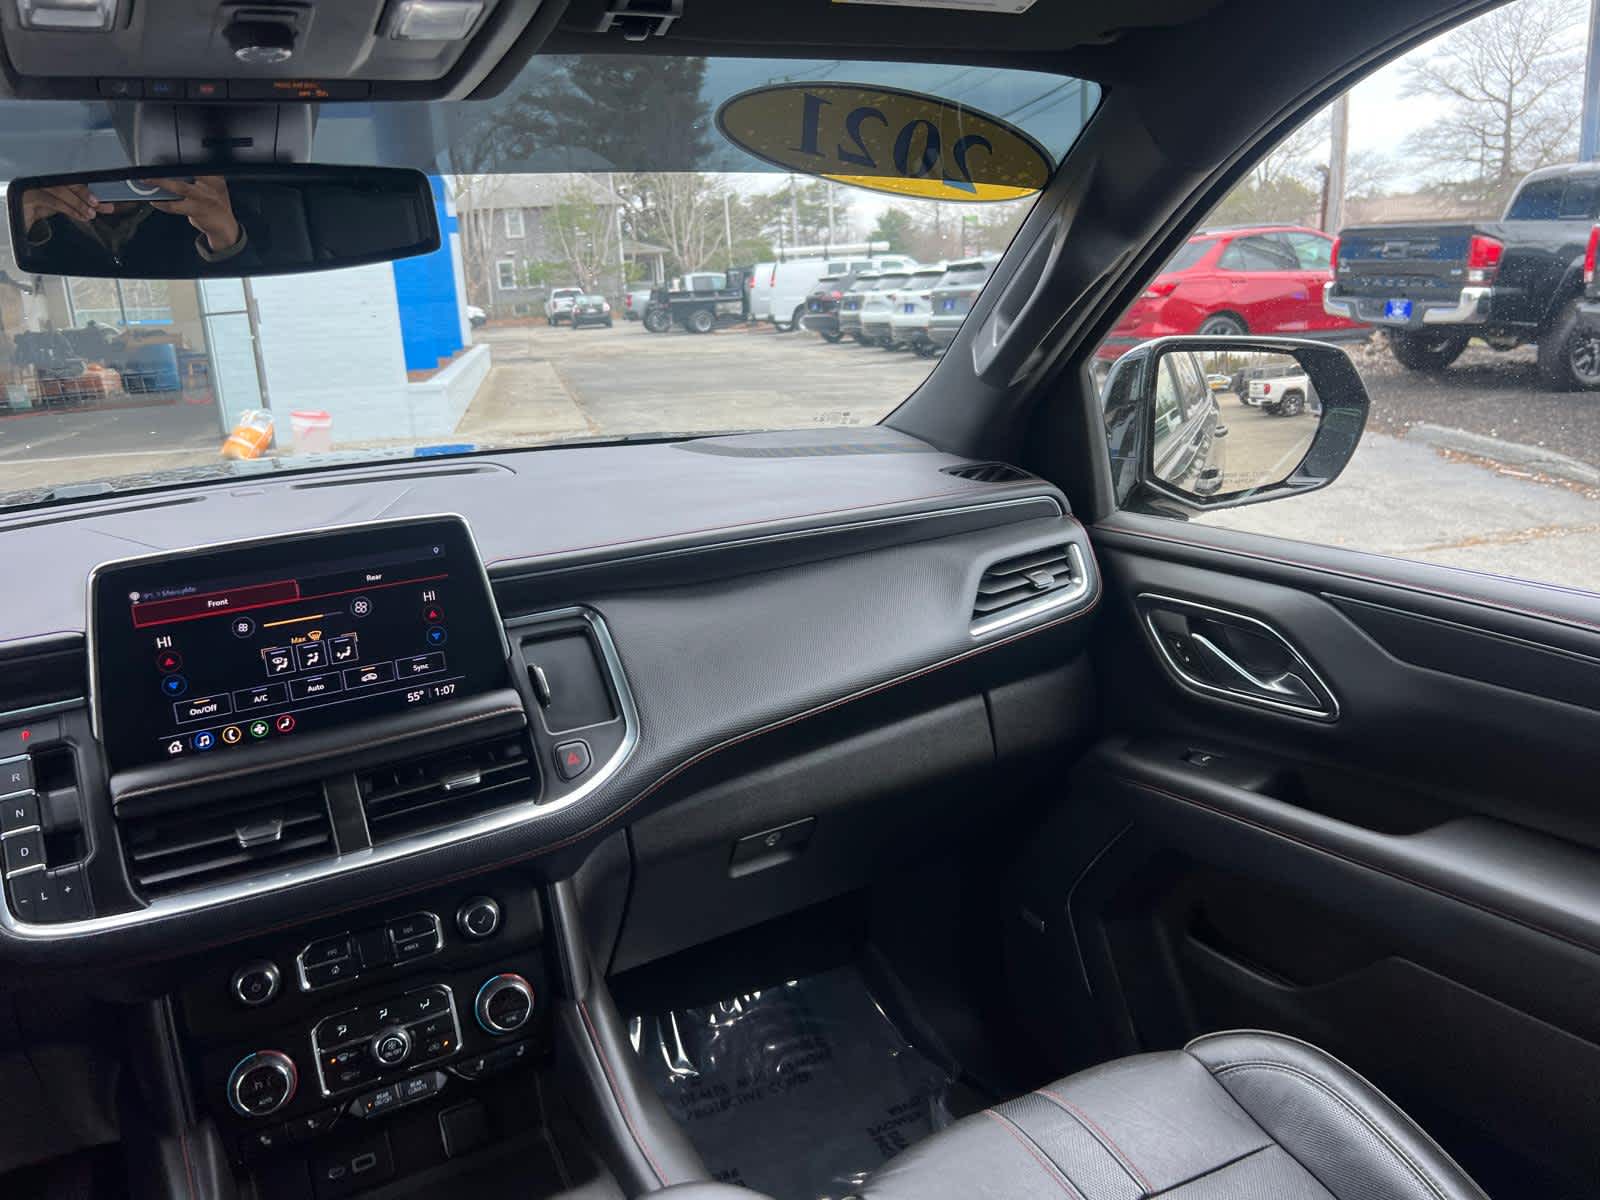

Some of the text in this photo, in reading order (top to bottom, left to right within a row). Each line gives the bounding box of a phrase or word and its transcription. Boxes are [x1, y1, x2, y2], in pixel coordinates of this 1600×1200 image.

[366, 574, 382, 582] Rear
[423, 590, 436, 602] HI
[207, 598, 229, 608] Front
[156, 635, 172, 649] HI
[412, 662, 430, 672] Sync
[307, 684, 325, 693] Auto
[434, 684, 456, 697] 1:07
[253, 694, 269, 703] A/C
[189, 704, 217, 716] On/Off
[11, 772, 21, 782] R
[15, 808, 24, 818] N
[20, 846, 29, 857] D
